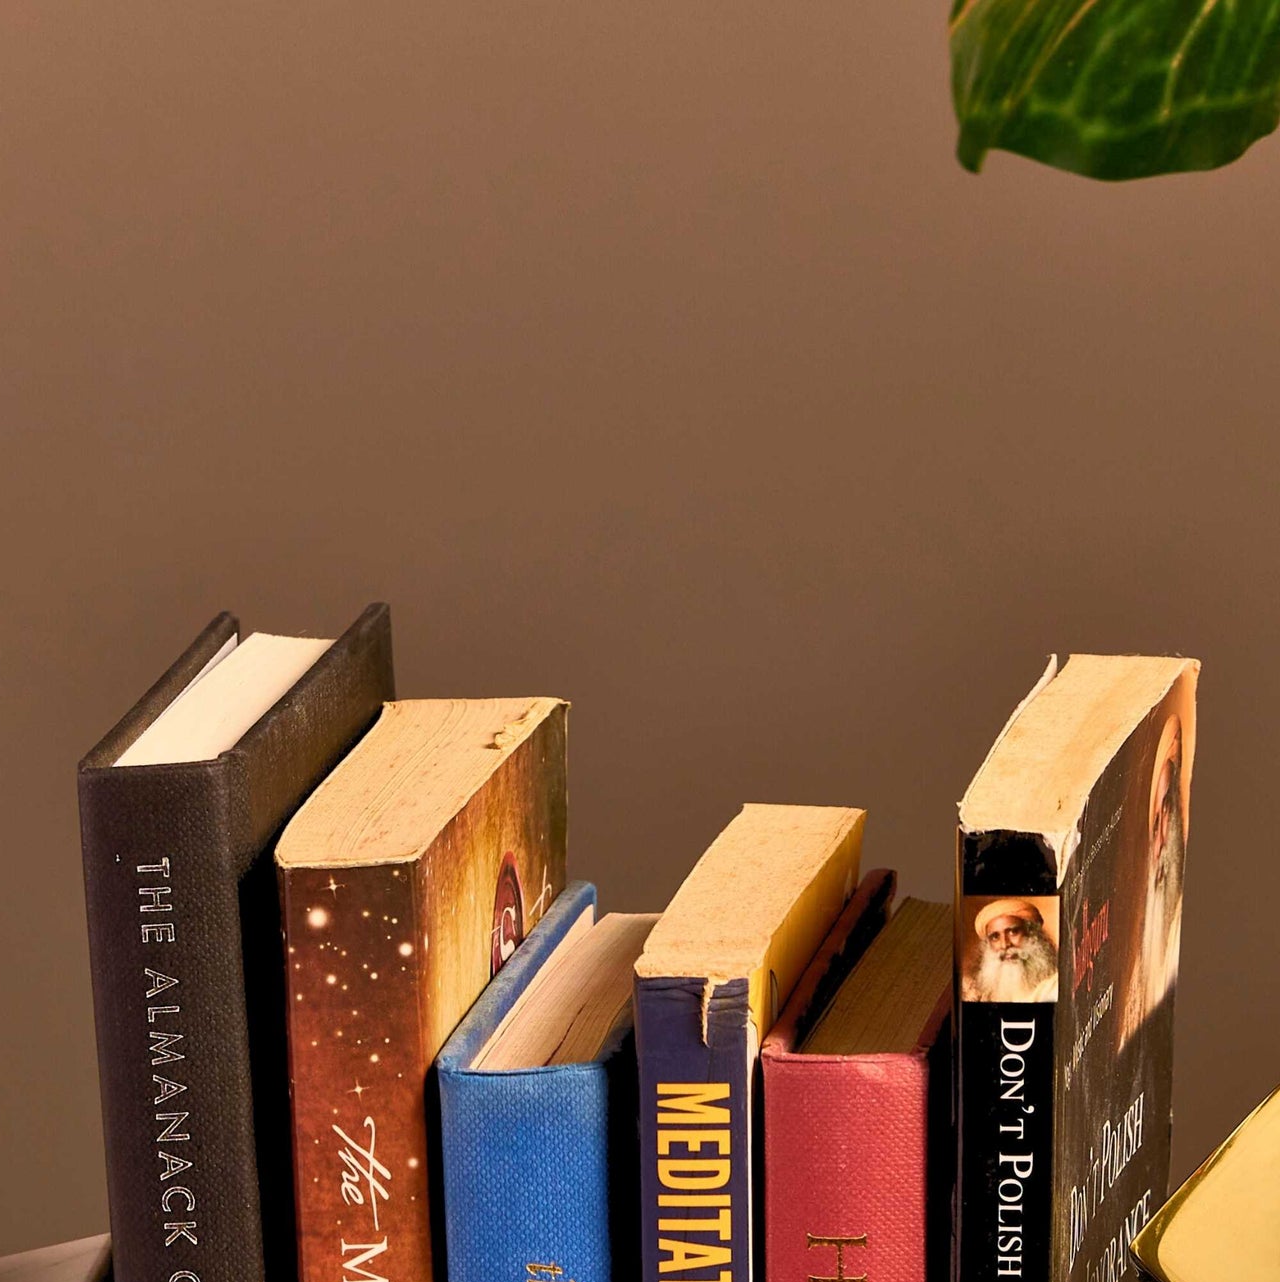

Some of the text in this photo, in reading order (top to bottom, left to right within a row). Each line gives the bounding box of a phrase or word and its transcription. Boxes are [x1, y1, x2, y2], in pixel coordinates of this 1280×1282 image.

[136, 857, 175, 943] THE
[144, 967, 198, 1247] ALMANACK
[999, 1018, 1036, 1140] DON'T
[1099, 1091, 1145, 1204] POLISH
[996, 1151, 1034, 1279] POLISH
